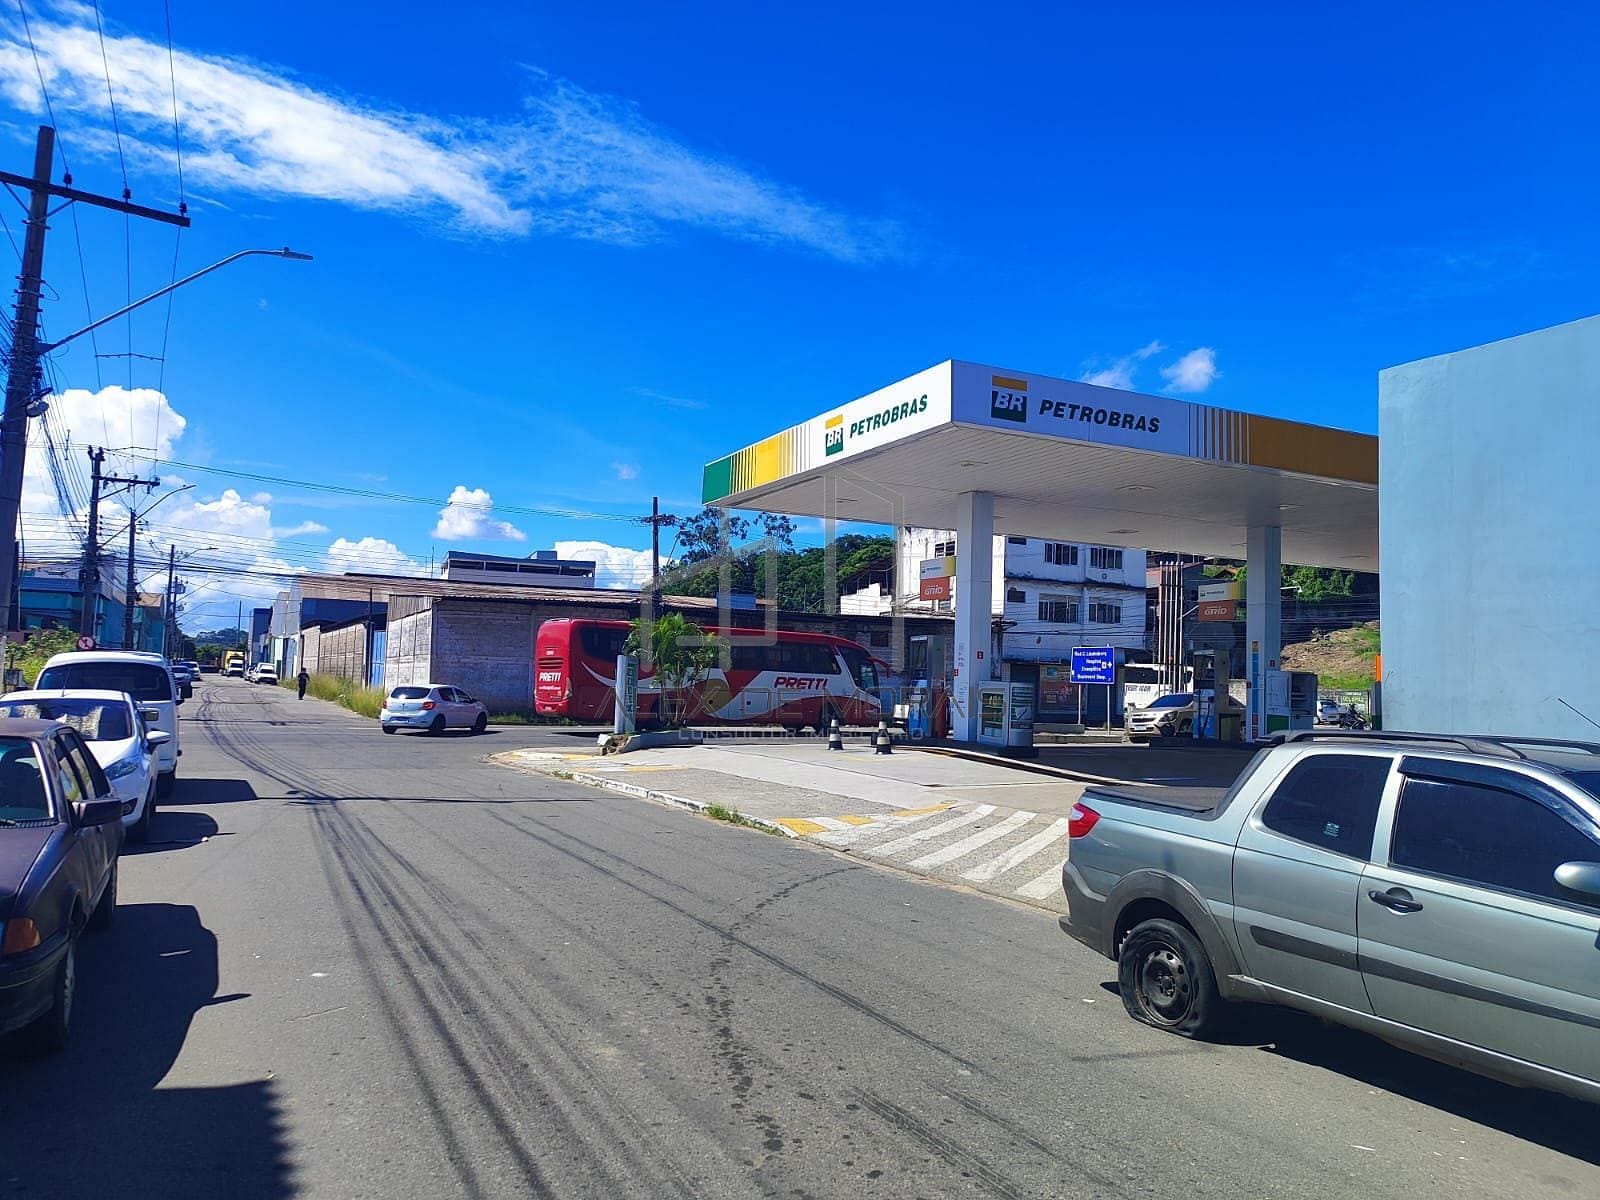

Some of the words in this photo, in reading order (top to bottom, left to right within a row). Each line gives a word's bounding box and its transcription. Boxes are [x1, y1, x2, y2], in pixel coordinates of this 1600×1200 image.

[992, 391, 1024, 413] BR
[1038, 399, 1161, 434] PETROBRAS
[826, 429, 842, 448] BR
[849, 393, 928, 438] PETROBRAS
[1204, 606, 1227, 616] GRID
[539, 672, 561, 682] PRETTI
[774, 676, 827, 690] PRETTI
